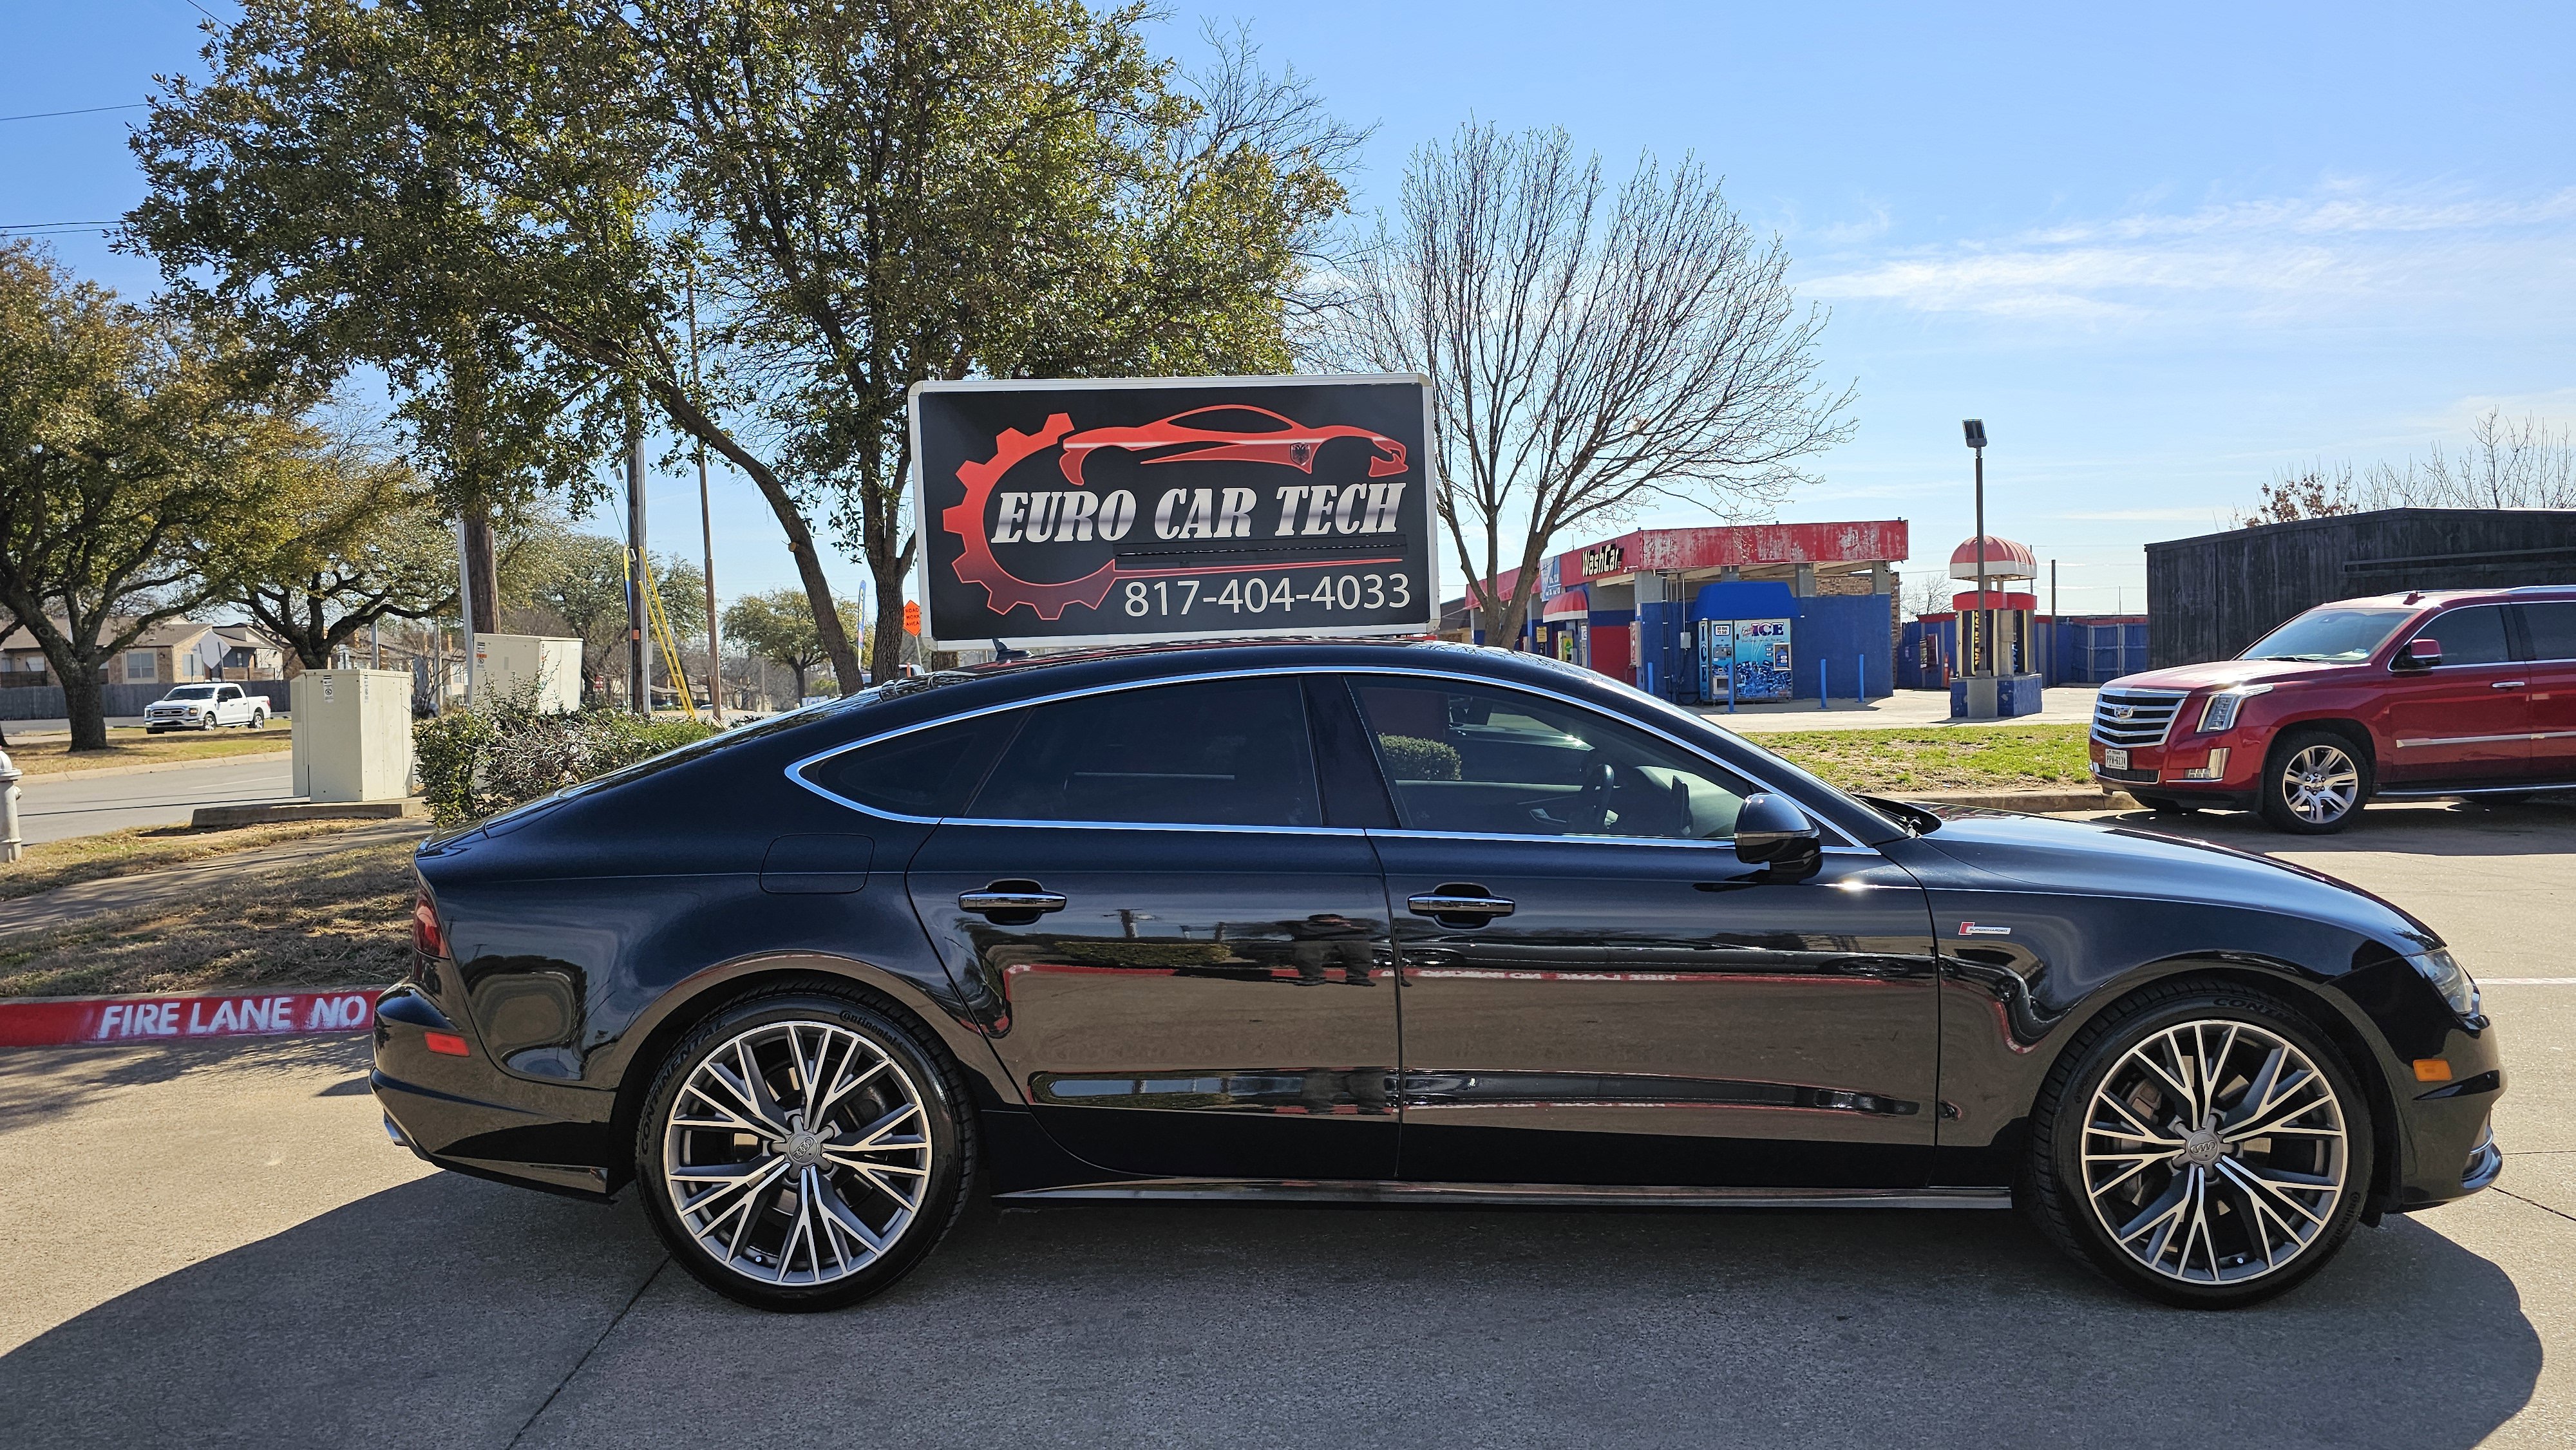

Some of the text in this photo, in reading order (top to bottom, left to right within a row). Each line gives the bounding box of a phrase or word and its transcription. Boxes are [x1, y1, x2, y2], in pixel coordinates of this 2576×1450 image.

[990, 482, 1406, 543] EURO CAR TECH
[1124, 573, 1410, 617] 817-404-4033
[1751, 622, 1784, 636] ICE
[99, 995, 367, 1039] FIRE LANE NO
[839, 1010, 898, 1046] Continental
